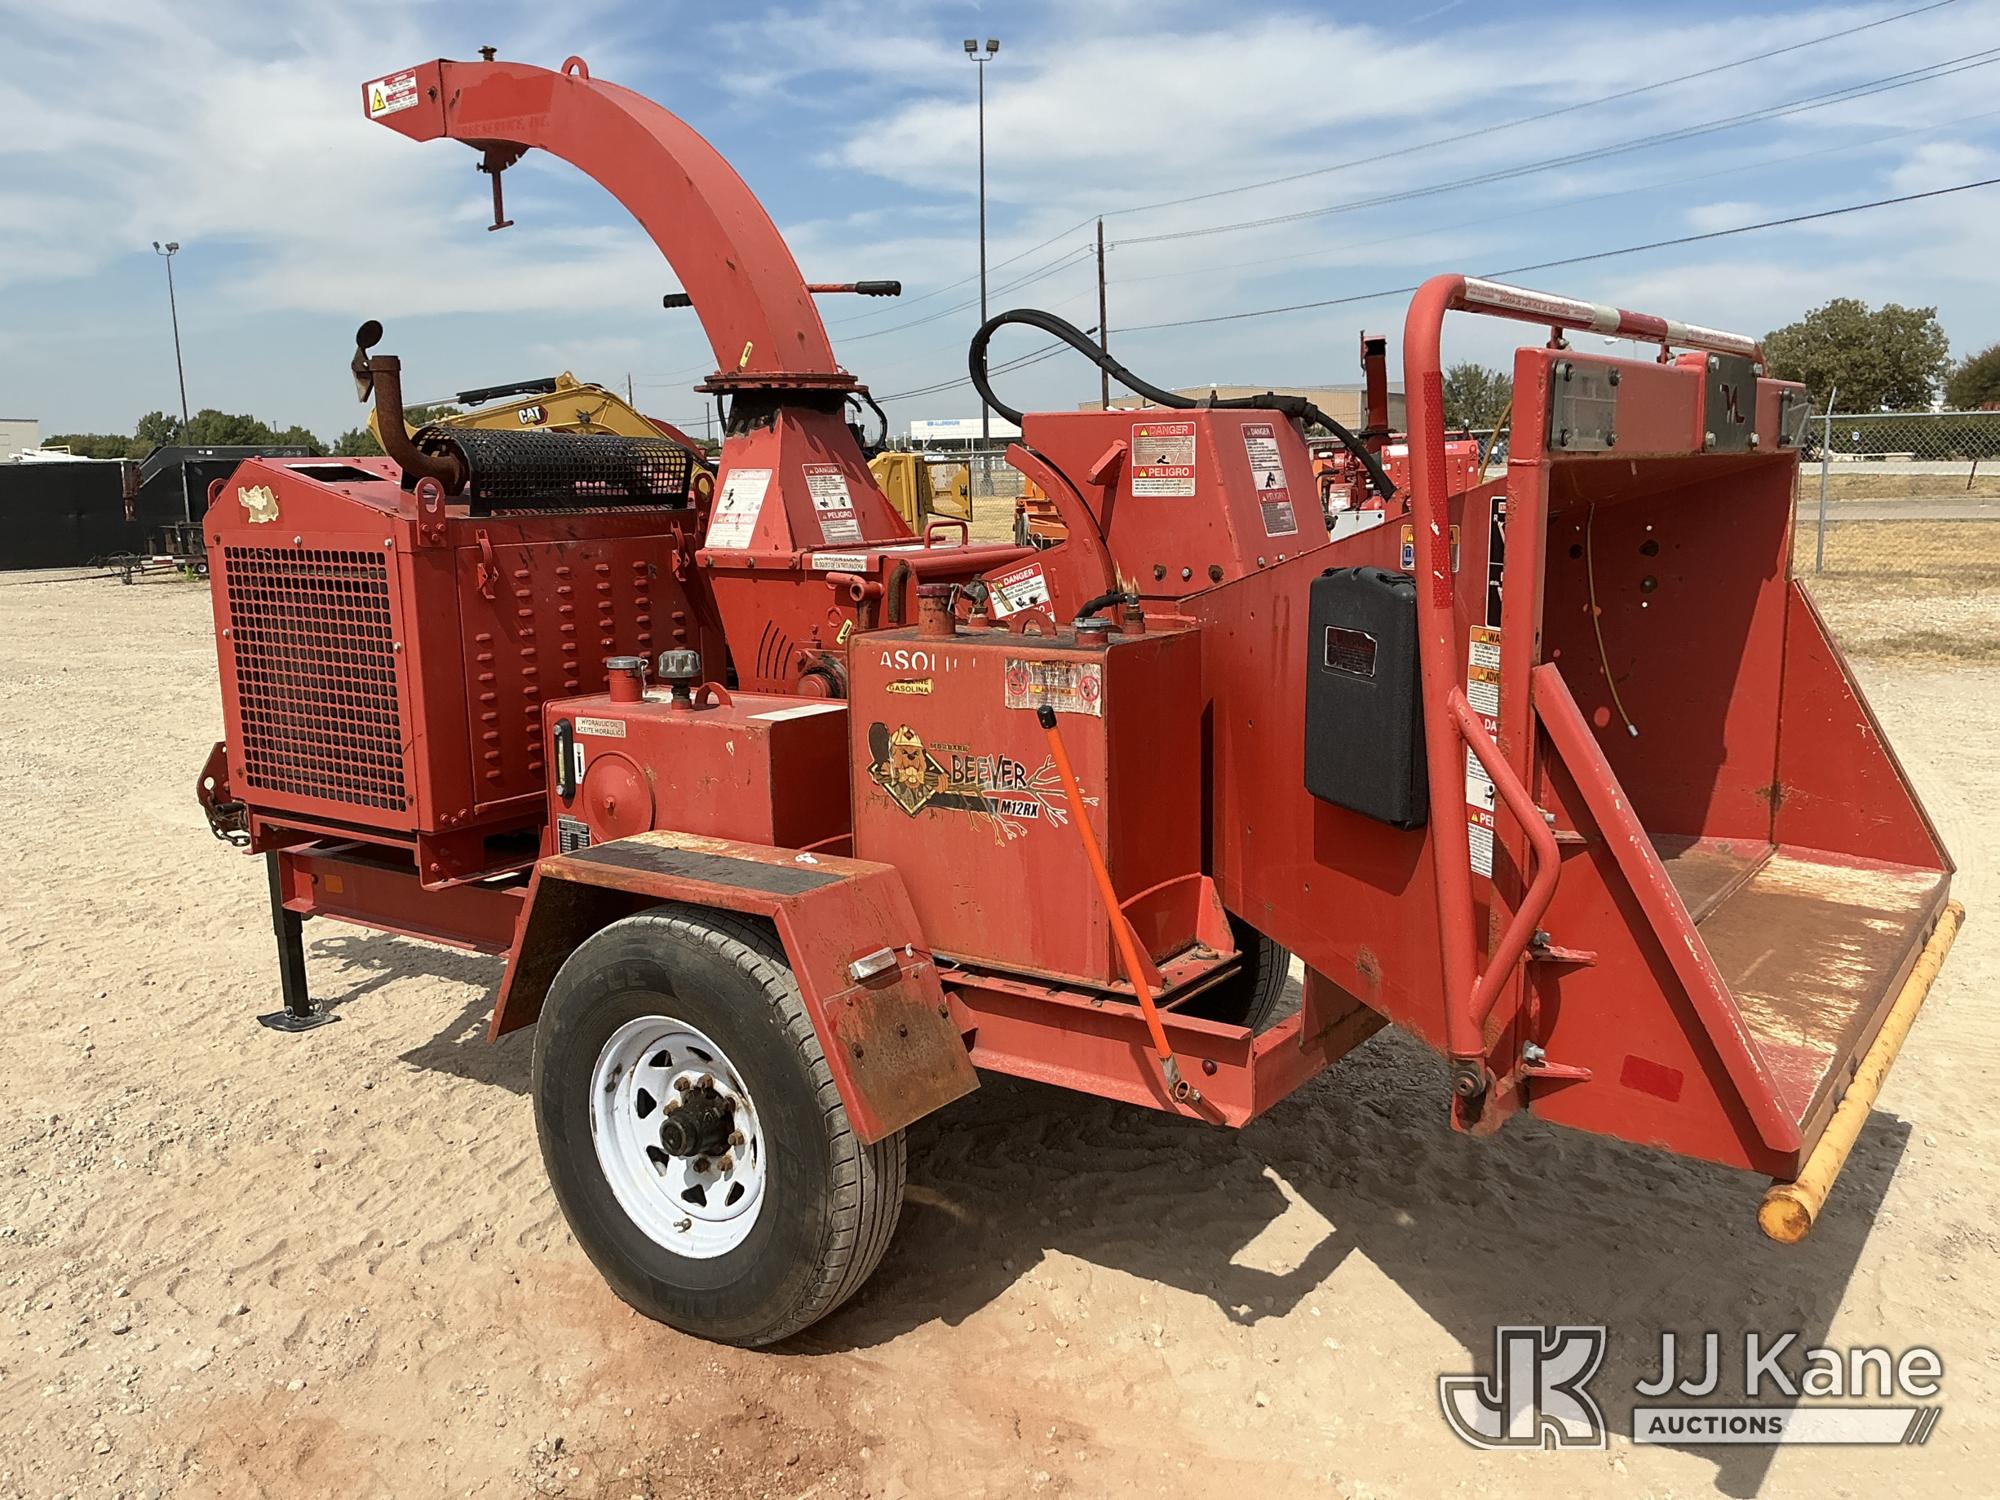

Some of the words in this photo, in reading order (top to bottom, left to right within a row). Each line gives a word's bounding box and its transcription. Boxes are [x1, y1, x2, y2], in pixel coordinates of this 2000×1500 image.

[518, 406, 541, 424] CAT
[1149, 425, 1189, 435] DANGER
[1250, 427, 1271, 436] DANGER
[1148, 467, 1190, 477] PELIGRO
[827, 511, 853, 519] PELIGRO
[1003, 568, 1035, 585] DANGER
[888, 684, 929, 694] GASOLINA
[951, 754, 1027, 789] BEEVER
[1000, 800, 1039, 817] M12RX
